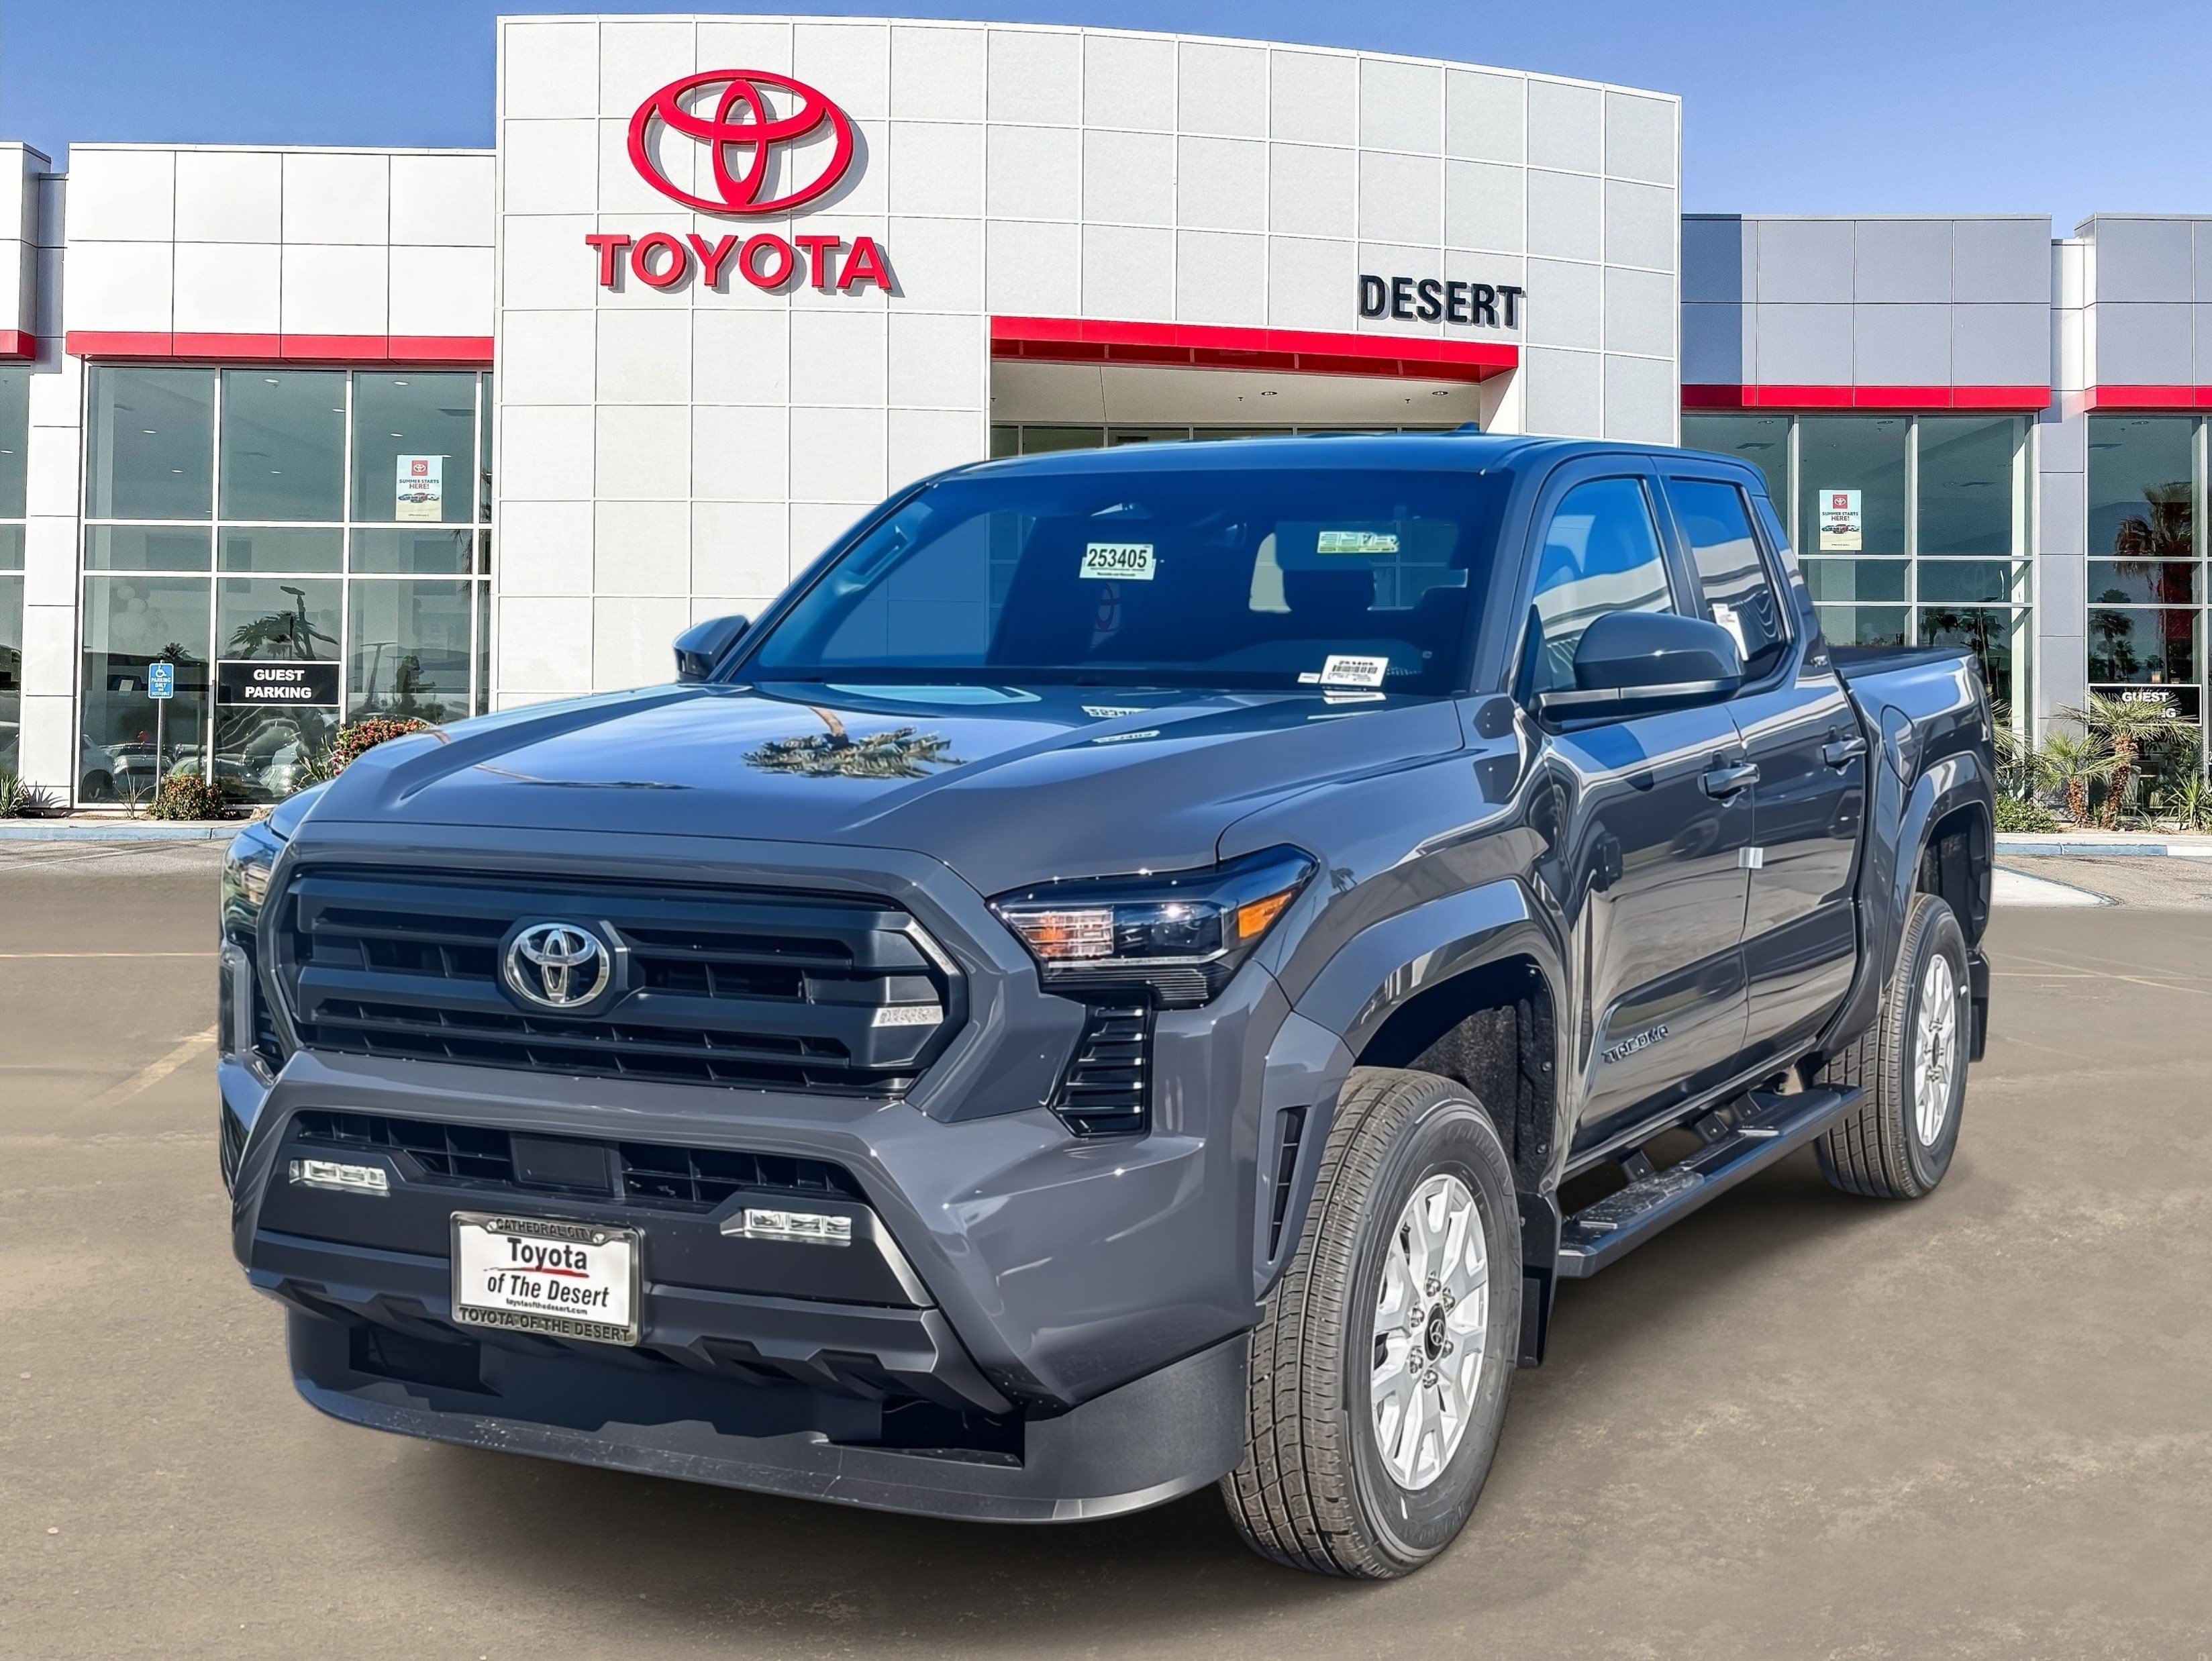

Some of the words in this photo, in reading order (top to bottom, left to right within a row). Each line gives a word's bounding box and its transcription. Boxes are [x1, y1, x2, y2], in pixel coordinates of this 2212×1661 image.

[585, 232, 893, 290] TOYOTA
[1359, 274, 1523, 326] DESERT
[1087, 548, 1147, 568] 253405
[253, 668, 305, 681] GUEST
[245, 686, 312, 699] PARKING
[2121, 691, 2169, 703] GUEST
[1601, 1023, 1669, 1064] TACOMA
[496, 1218, 564, 1236] CATHEDRAL
[567, 1226, 595, 1242] CITY
[507, 1238, 587, 1271] Toyota
[487, 1274, 506, 1293] of
[511, 1275, 541, 1298] The
[548, 1280, 609, 1307] Desert
[460, 1307, 515, 1326] TOYOTA
[520, 1316, 537, 1327] OF
[542, 1317, 570, 1333] THE
[574, 1322, 630, 1342] DESERT
